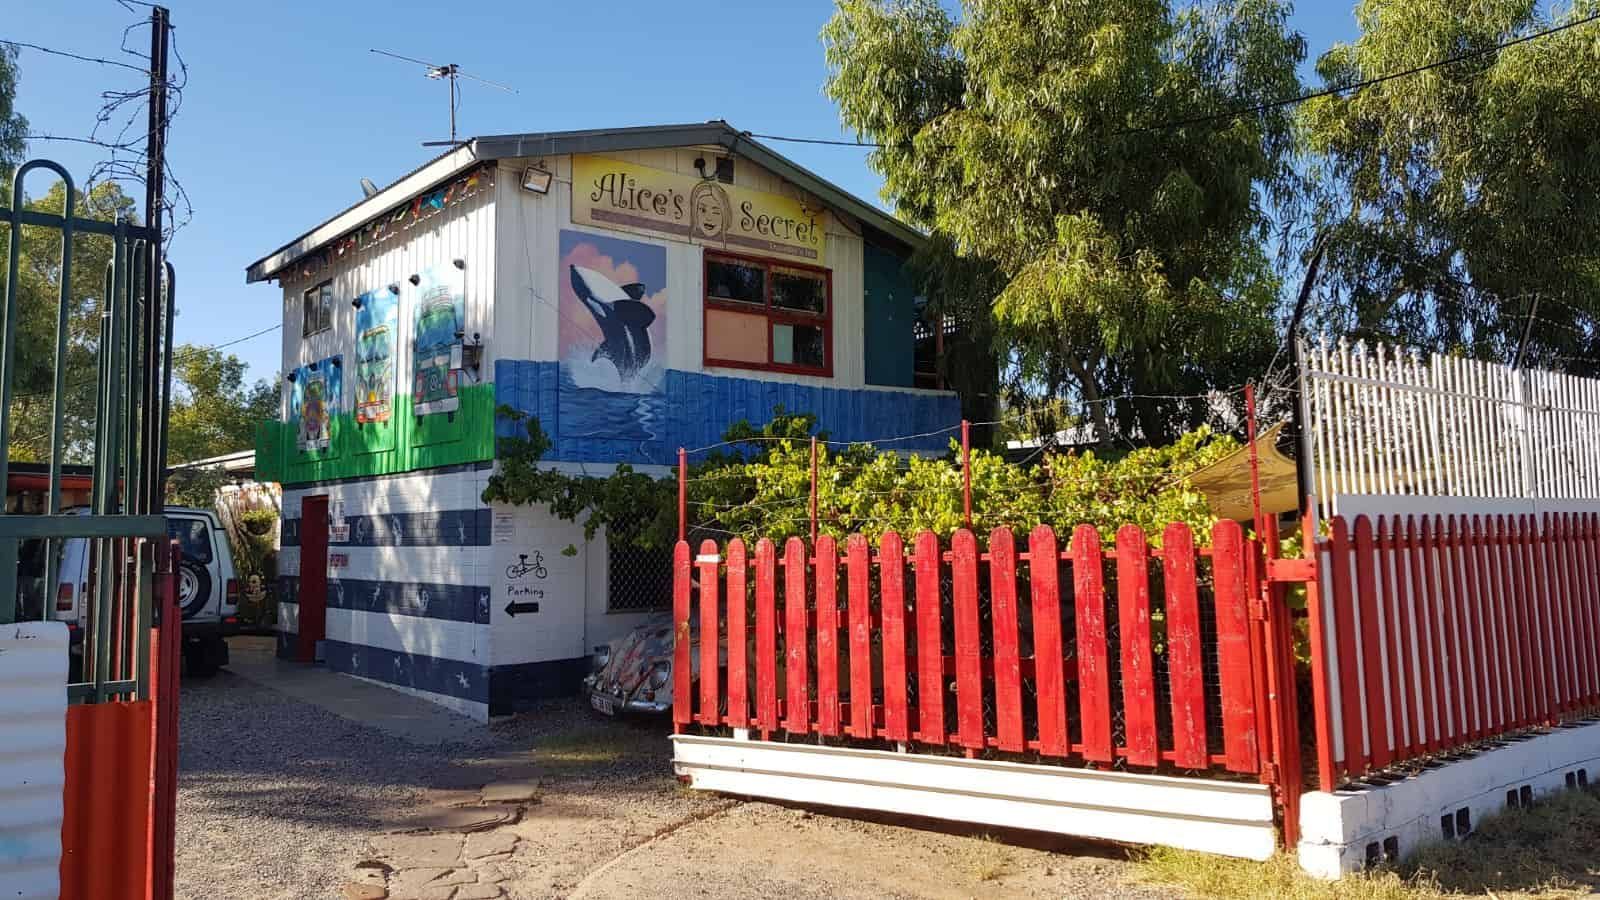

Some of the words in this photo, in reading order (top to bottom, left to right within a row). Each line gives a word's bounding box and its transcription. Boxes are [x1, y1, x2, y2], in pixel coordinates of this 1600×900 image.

[591, 173, 684, 220] Alice's
[740, 201, 818, 244] Secret
[507, 585, 544, 599] Parking
